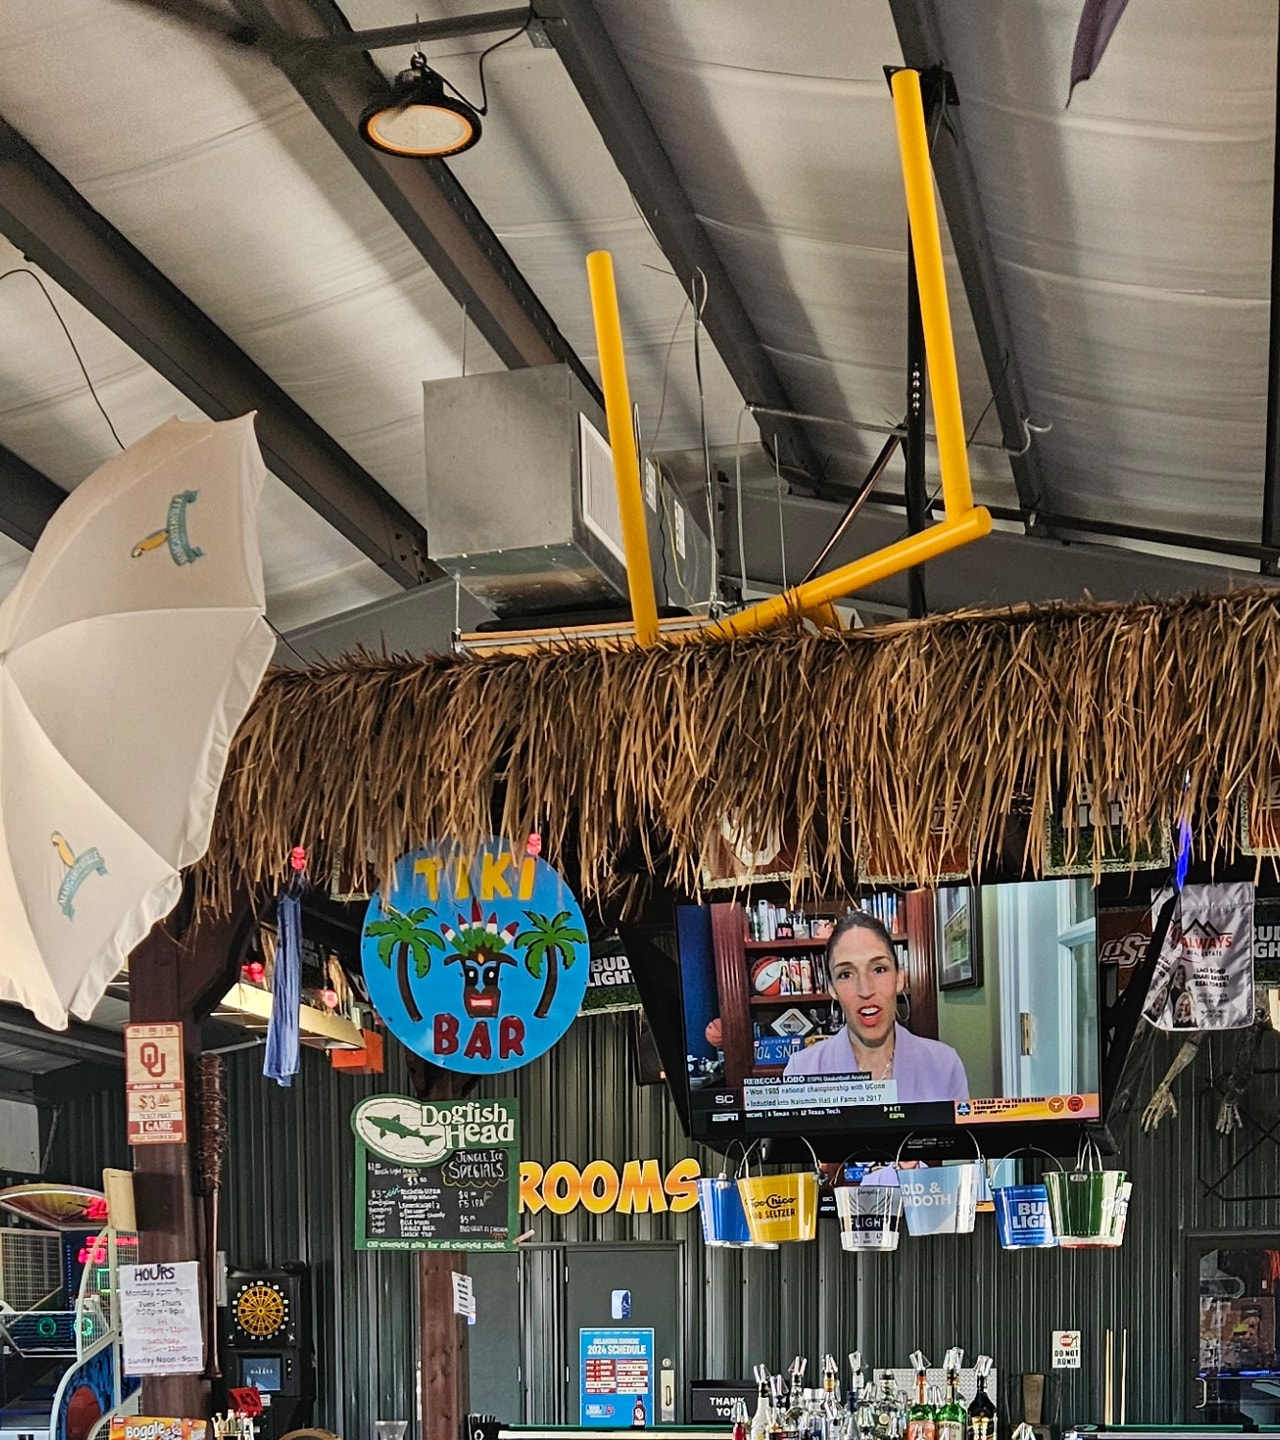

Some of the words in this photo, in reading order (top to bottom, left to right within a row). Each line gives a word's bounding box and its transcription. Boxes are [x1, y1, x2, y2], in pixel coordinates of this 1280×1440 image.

[414, 852, 536, 901] TIKI
[1180, 936, 1233, 950] ALWAYS
[590, 956, 631, 973] BUD
[433, 1013, 526, 1061] BAR
[743, 1076, 781, 1086] REBECCA
[783, 1075, 805, 1085] LOBO
[781, 1086, 806, 1095] national
[807, 1084, 850, 1094] championship
[851, 1083, 864, 1091] with
[714, 1095, 734, 1104] SC
[819, 1096, 831, 1104] Hall
[840, 1095, 857, 1103] Fame
[866, 1094, 882, 1102] 2017
[421, 1102, 507, 1126] Dogfish
[712, 1113, 739, 1122] ESPN
[145, 1120, 173, 1132] GAME
[445, 1118, 515, 1149] Head
[448, 1161, 505, 1180] SPECIALS
[929, 1181, 942, 1194] &
[766, 1193, 798, 1209] Chico
[765, 1208, 796, 1219] SELTZER
[134, 1266, 176, 1281] HOURS
[125, 1289, 154, 1298] Monday
[161, 1299, 182, 1307] Thurs
[587, 1345, 607, 1355] 2024
[607, 1344, 647, 1355] SCHEDULE
[1065, 1349, 1079, 1357] NOT
[127, 1357, 155, 1365] Sunday
[155, 1356, 177, 1364] Noon
[709, 1397, 745, 1406] THANK
